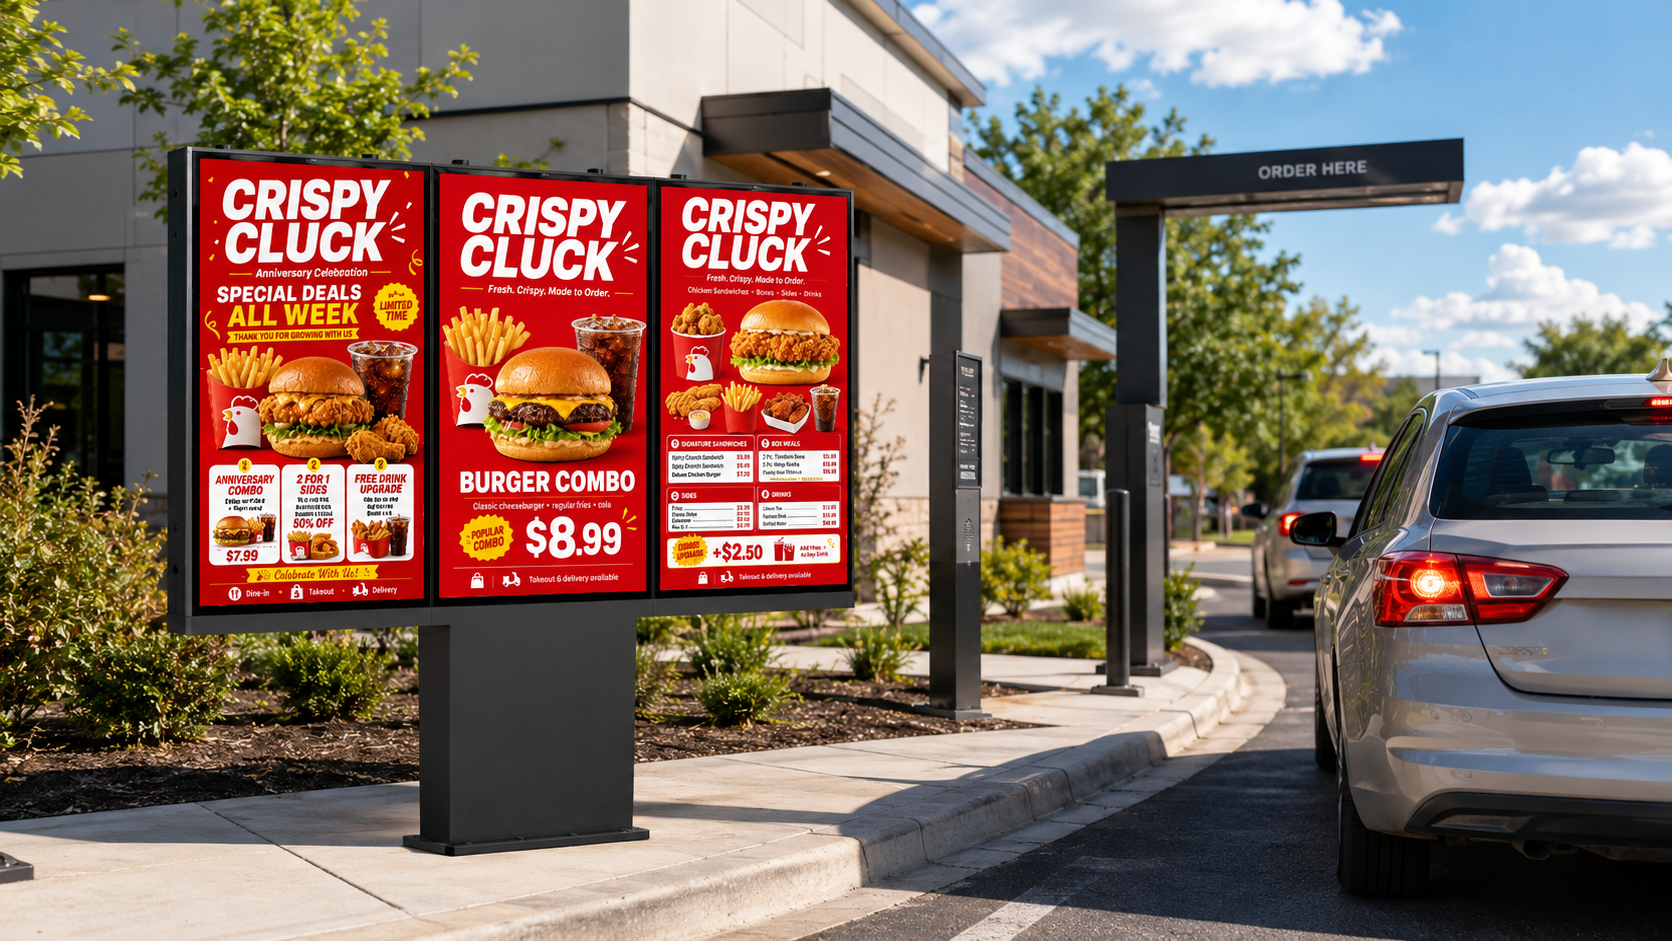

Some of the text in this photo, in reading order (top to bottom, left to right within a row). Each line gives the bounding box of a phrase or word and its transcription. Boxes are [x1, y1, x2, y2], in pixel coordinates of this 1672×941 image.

[1258, 160, 1368, 180] ORDER HERE
[222, 178, 392, 220] CRISPY
[462, 192, 626, 239] CRISPY
[682, 196, 816, 236] CRISPY
[225, 222, 387, 264] CLUCK
[460, 234, 619, 282] CLUCK
[682, 232, 812, 272] CLUCK
[255, 268, 312, 280] Anniversary
[706, 274, 728, 282] Fresh.
[729, 274, 754, 284] Crispy.
[755, 276, 774, 284] Made
[216, 284, 362, 303] SPECIAL DEALS
[488, 284, 610, 298] Fresh. Crispy. Made to Order.
[380, 300, 412, 310] LIMITED
[227, 302, 360, 328] ALL WEEK
[386, 310, 408, 320] TIME
[234, 330, 352, 341] THANK YOU FOR GROWING WITH US
[215, 474, 274, 485] ANNIVERSARY
[296, 474, 330, 484] 2 FOR 1
[354, 474, 408, 484] FREE DRINK
[460, 470, 636, 494] BURGER COMBO
[228, 486, 264, 496] COMBO
[300, 484, 328, 494] SIDES
[360, 484, 403, 494] UPGRADE
[576, 501, 591, 509] fries
[293, 518, 334, 528] 50% OFF
[472, 526, 504, 538] POPULAR
[526, 516, 622, 558] $8.99
[473, 536, 504, 552] COMBO
[226, 550, 258, 562] $7.99
[712, 542, 763, 562] +$2.50
[317, 568, 340, 579] With
[562, 574, 588, 583] delivery
[246, 590, 270, 598] Dine-in
